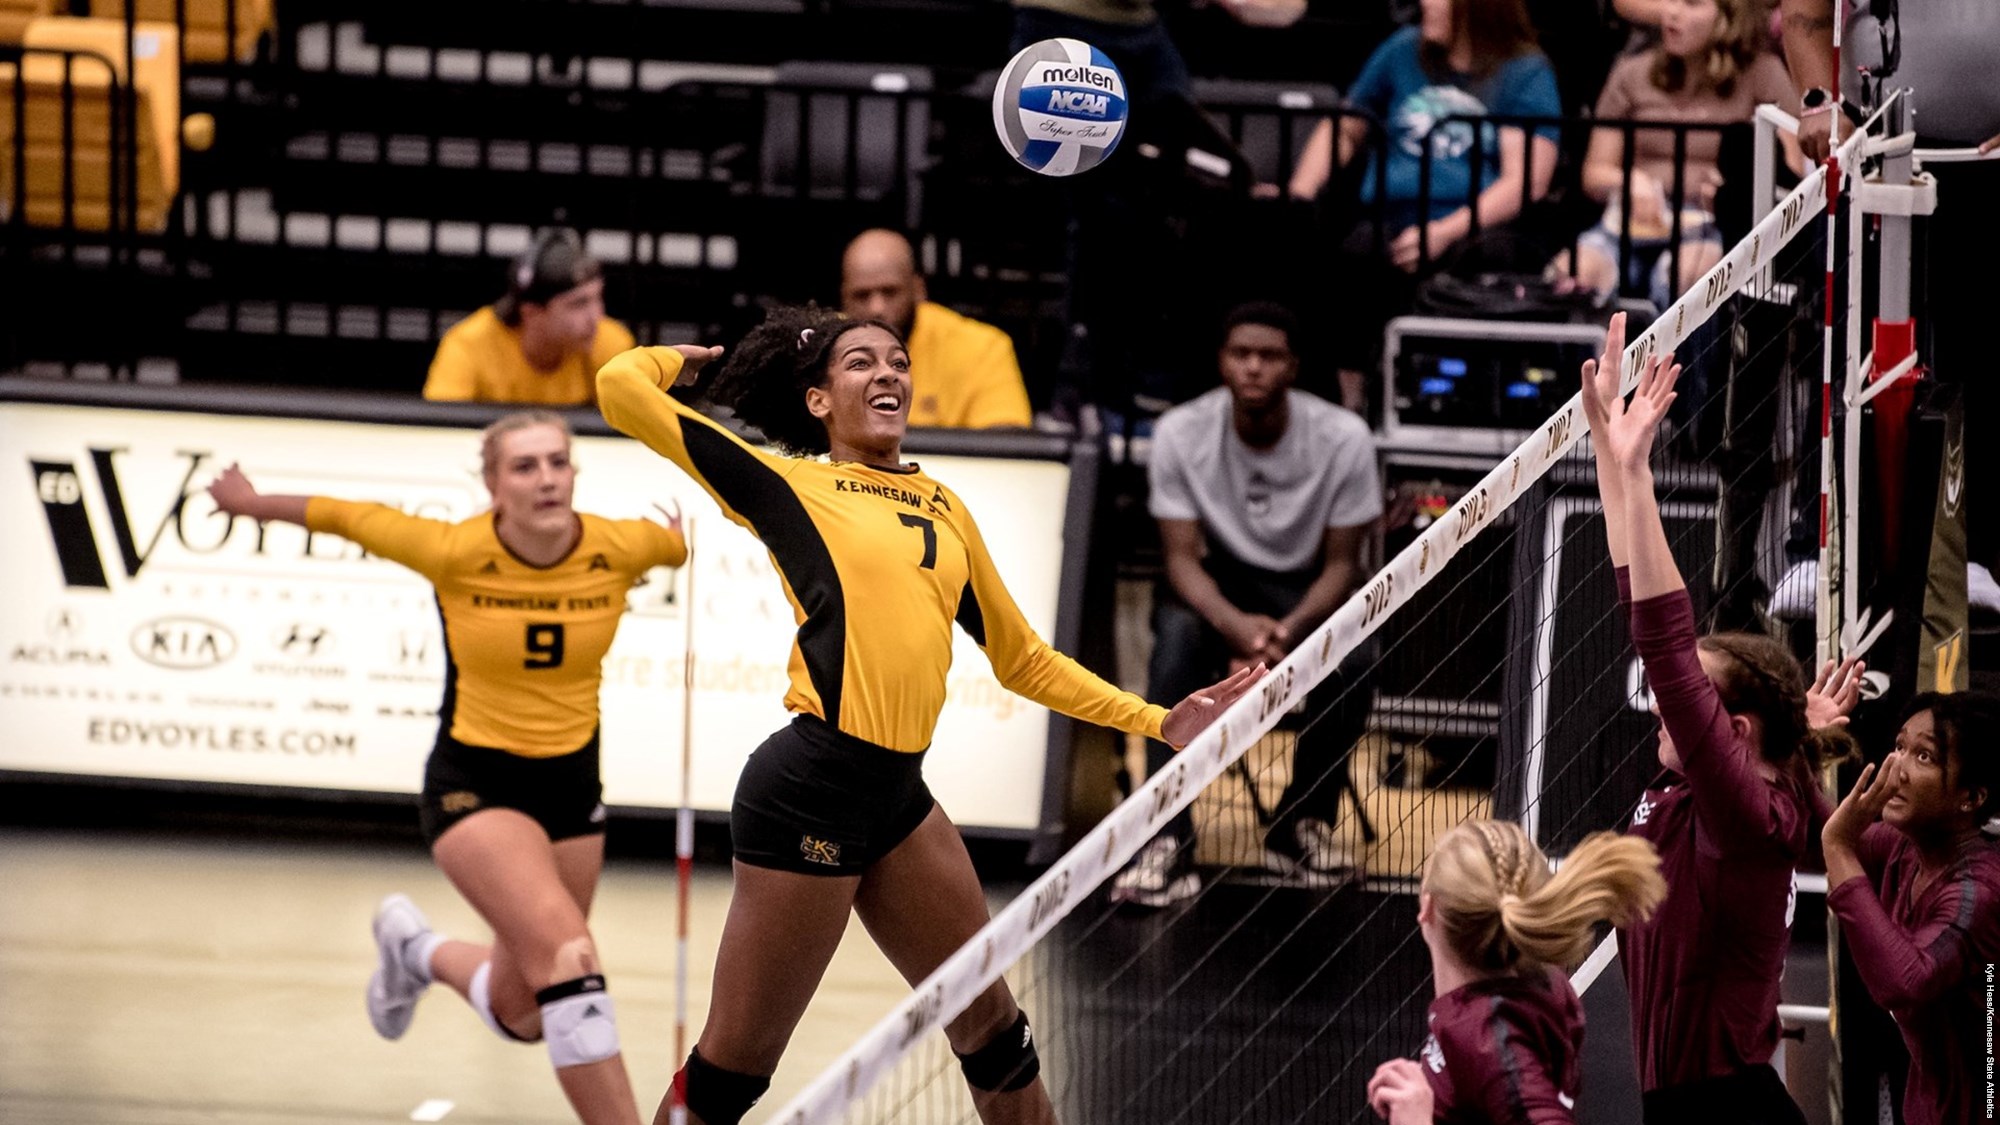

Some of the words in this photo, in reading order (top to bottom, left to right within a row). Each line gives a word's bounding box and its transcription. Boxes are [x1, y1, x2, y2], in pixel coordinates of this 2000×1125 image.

[1043, 67, 1113, 91] molten
[1047, 89, 1110, 117] NCAA
[1039, 119, 1073, 138] Super
[1076, 125, 1108, 139] Touch
[38, 471, 83, 506] ED
[835, 479, 921, 509] KENNESAW
[896, 511, 937, 570] 7
[473, 594, 559, 611] KENNESAW
[567, 594, 610, 611] STATE
[9, 644, 112, 667] ACURA
[150, 630, 221, 664] KIA
[523, 622, 565, 669] 9
[86, 719, 357, 757] EDVOYLES.COM
